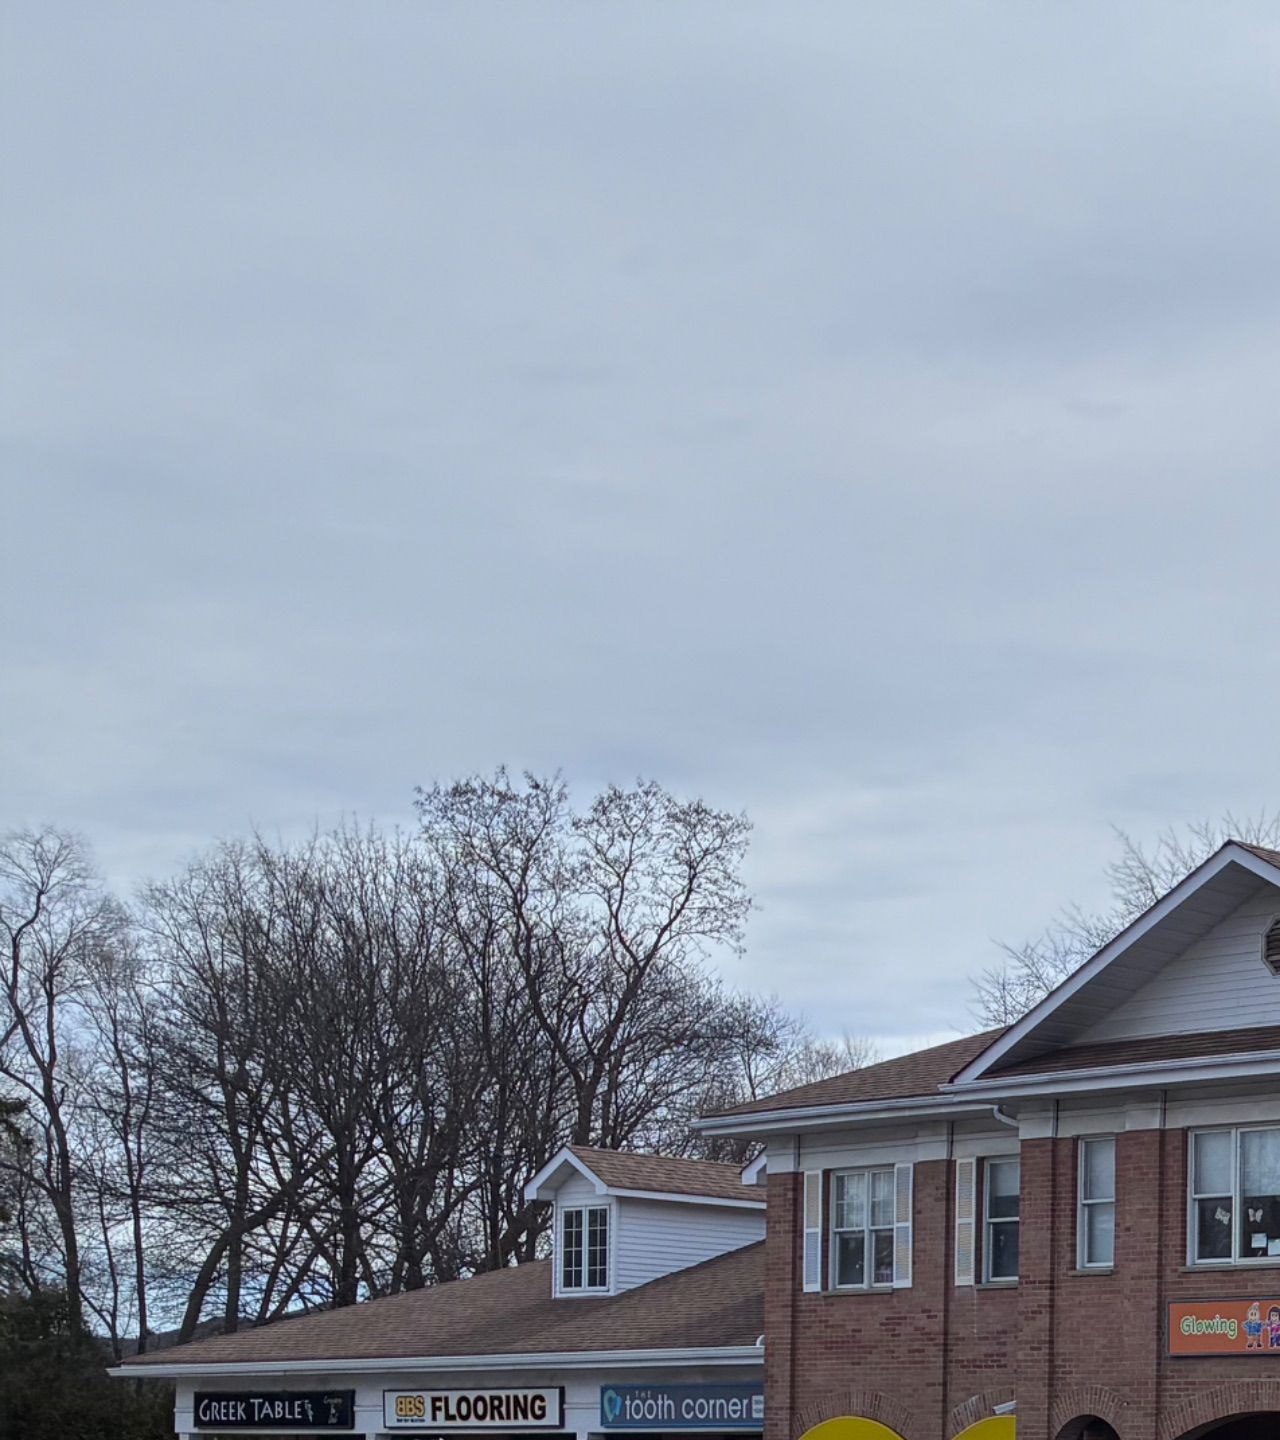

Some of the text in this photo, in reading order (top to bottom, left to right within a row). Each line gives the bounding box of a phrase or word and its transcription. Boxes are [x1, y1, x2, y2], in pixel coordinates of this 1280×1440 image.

[1180, 1314, 1238, 1339] Glowing
[199, 1399, 247, 1421] GREEK
[250, 1399, 303, 1420] TABLE
[431, 1394, 547, 1422] FLOORING
[625, 1394, 676, 1420] tooth
[682, 1398, 748, 1419] corner
